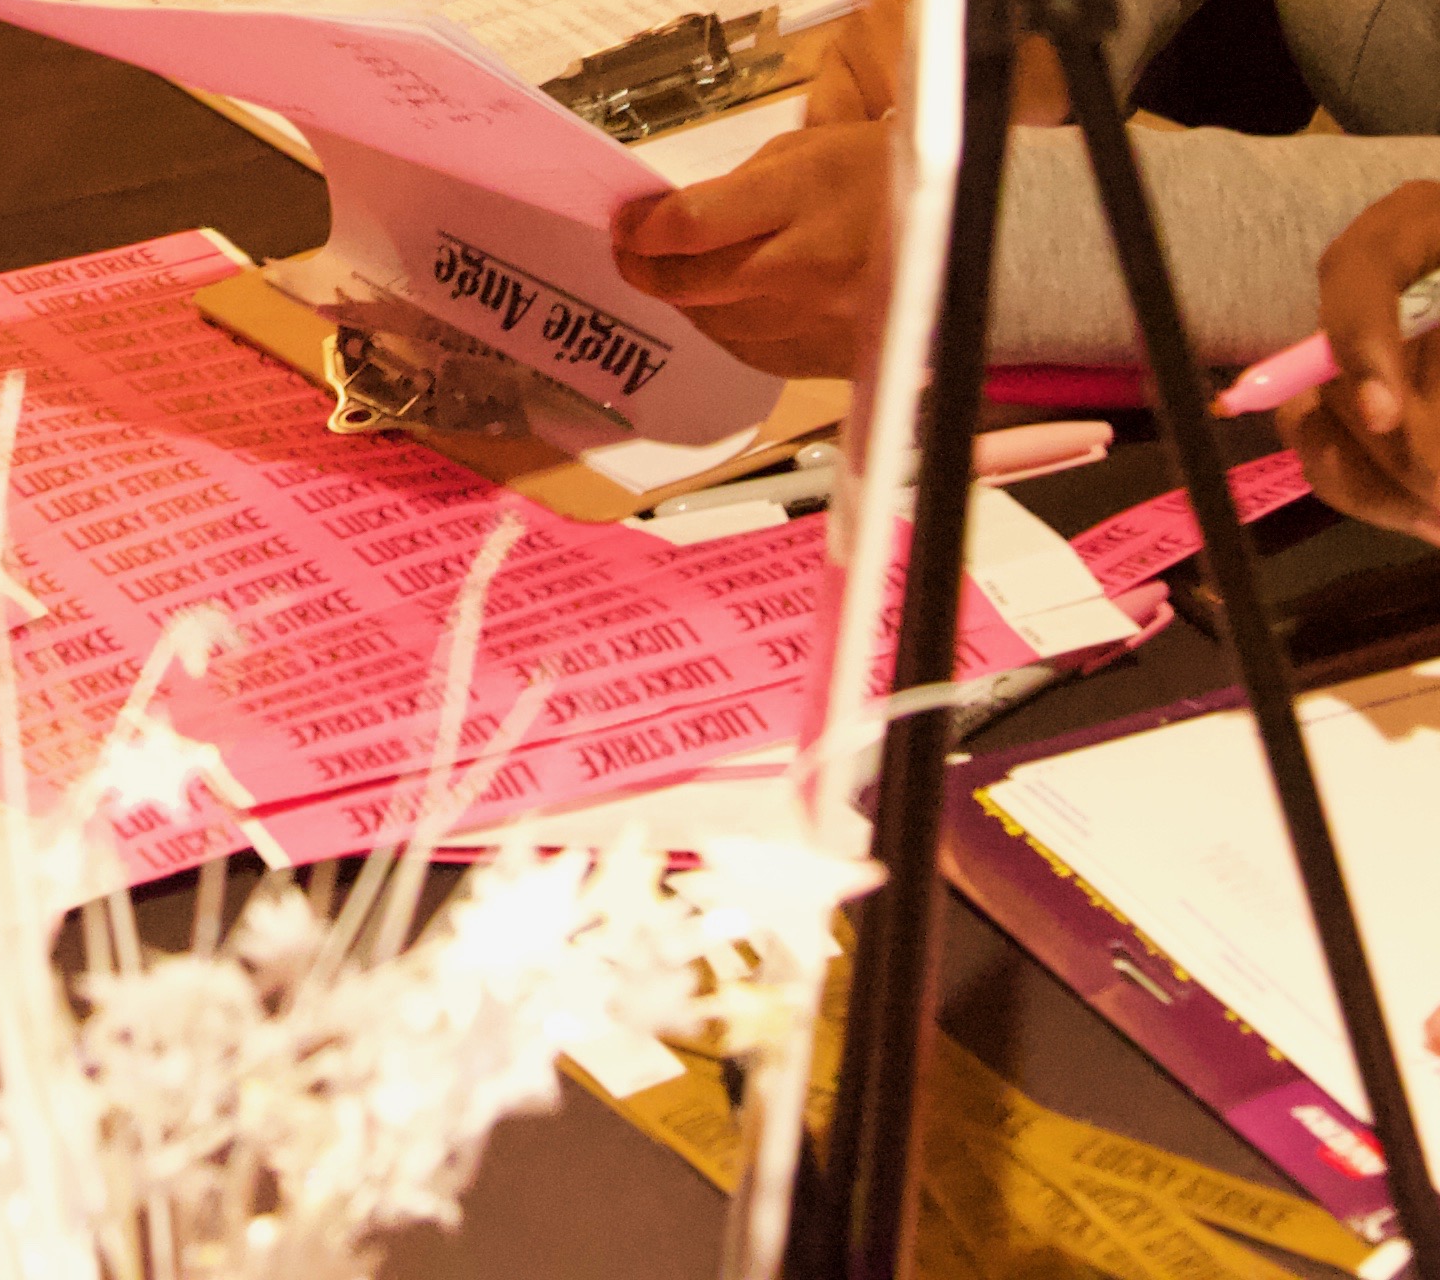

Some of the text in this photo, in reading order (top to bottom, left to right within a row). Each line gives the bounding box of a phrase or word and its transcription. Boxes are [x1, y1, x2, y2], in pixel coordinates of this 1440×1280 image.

[0, 248, 164, 297] LUCKY STRIKE
[23, 270, 187, 319] LUCKY STRIKE
[432, 243, 539, 333] Ange
[541, 302, 669, 398] Angie
[9, 442, 183, 500] LUCKY STRIKE
[33, 460, 211, 524] LUCKY STRIKE
[290, 476, 378, 515] LUCKY
[60, 482, 241, 552] LUCKY STRIKE
[321, 501, 410, 541] LUCKY
[88, 534, 179, 578] LUCKY
[174, 506, 270, 551] STRIKE
[352, 525, 442, 568] LUCKY
[117, 562, 209, 605] LUCKY
[203, 533, 300, 577] STRIKE
[232, 559, 333, 607] STRIKE
[383, 551, 471, 599] LUCKY
[265, 587, 363, 636] STRIKE
[723, 585, 819, 635] STRIKE
[606, 617, 704, 664] LUCKY
[543, 654, 735, 727] LUCKY STRIKE
[308, 737, 413, 782] STRIKE
[573, 701, 770, 782] LUCKY STRIKE
